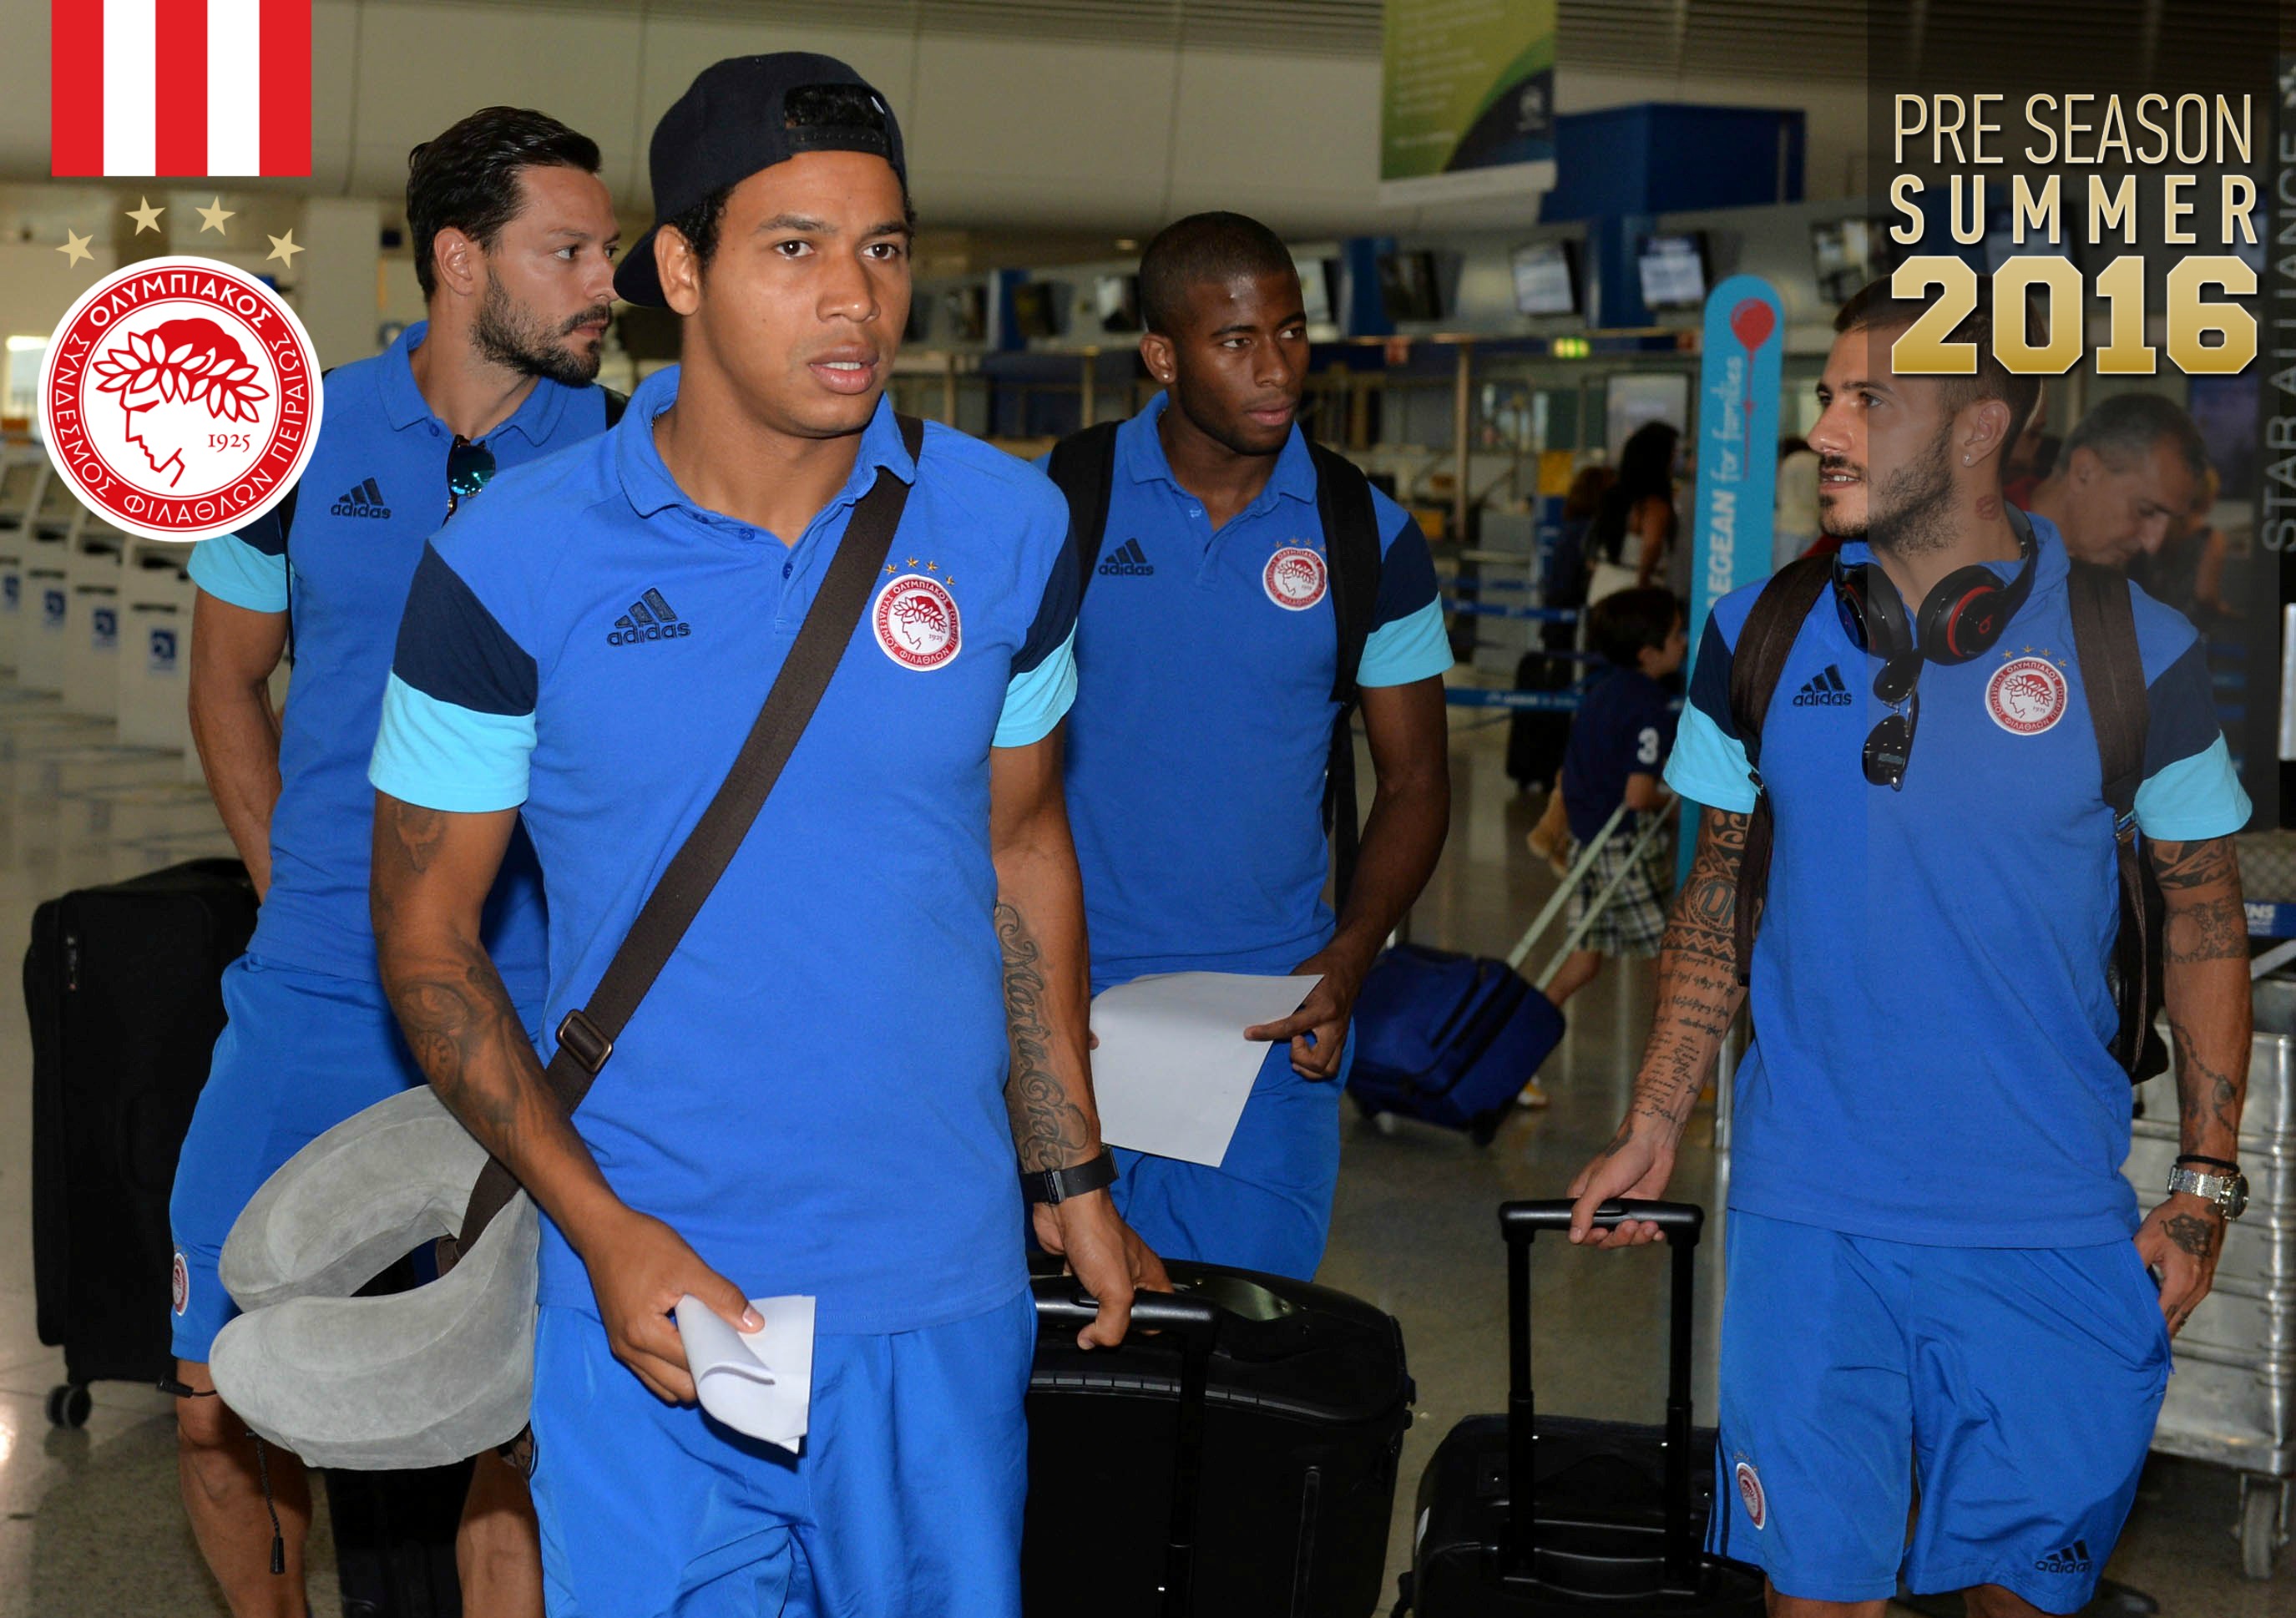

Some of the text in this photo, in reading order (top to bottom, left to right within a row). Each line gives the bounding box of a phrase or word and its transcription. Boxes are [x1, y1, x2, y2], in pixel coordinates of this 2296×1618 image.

[2262, 416, 2296, 554] STAR
[331, 502, 392, 519] adidas
[1098, 562, 1154, 576] adidas
[606, 621, 691, 646] adidas
[1792, 690, 1852, 707] adidas
[1637, 727, 1659, 764] 3
